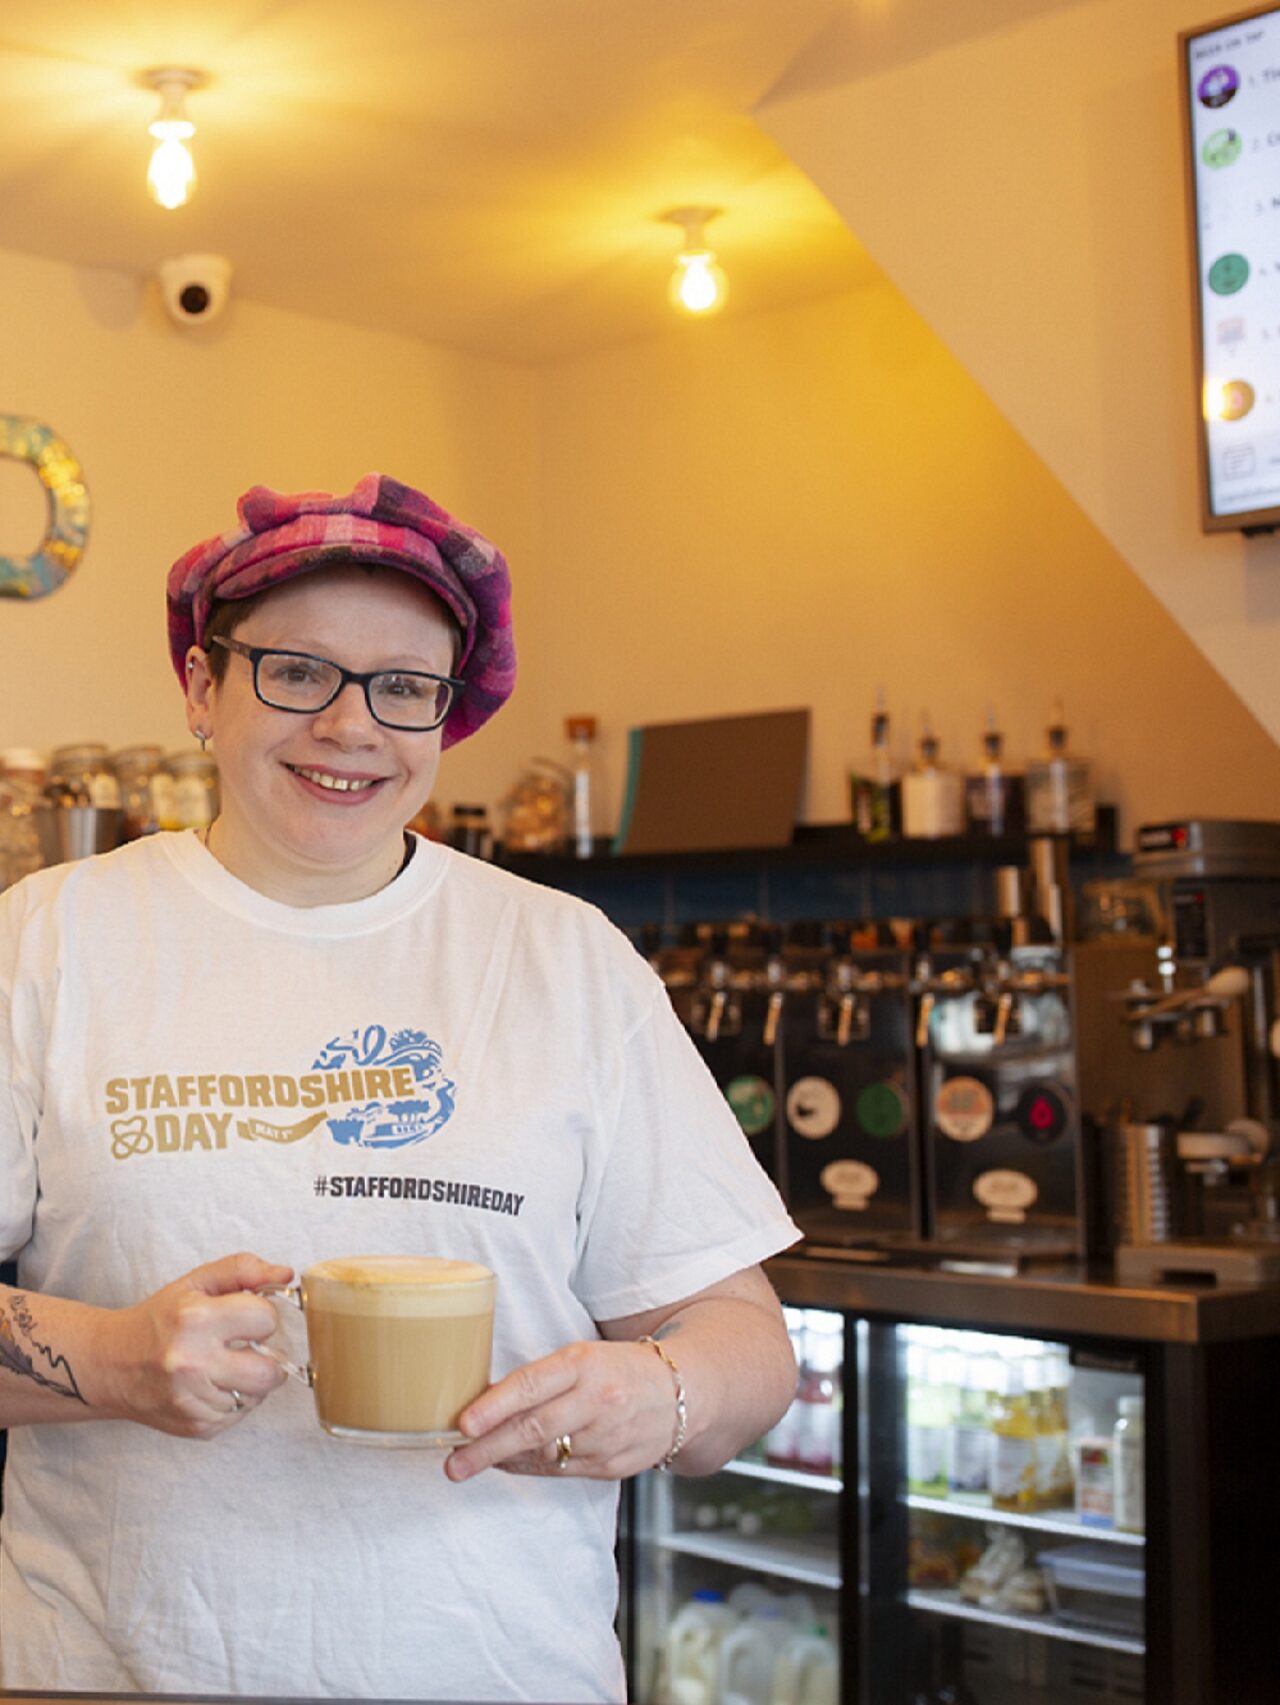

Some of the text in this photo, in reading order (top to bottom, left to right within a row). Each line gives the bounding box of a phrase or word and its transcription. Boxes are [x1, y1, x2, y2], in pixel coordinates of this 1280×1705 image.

[106, 1068, 415, 1114] STAFFORDSHIRE
[155, 1113, 233, 1153] DAY
[314, 1174, 525, 1216] #STAFFORDSHIREDAY
